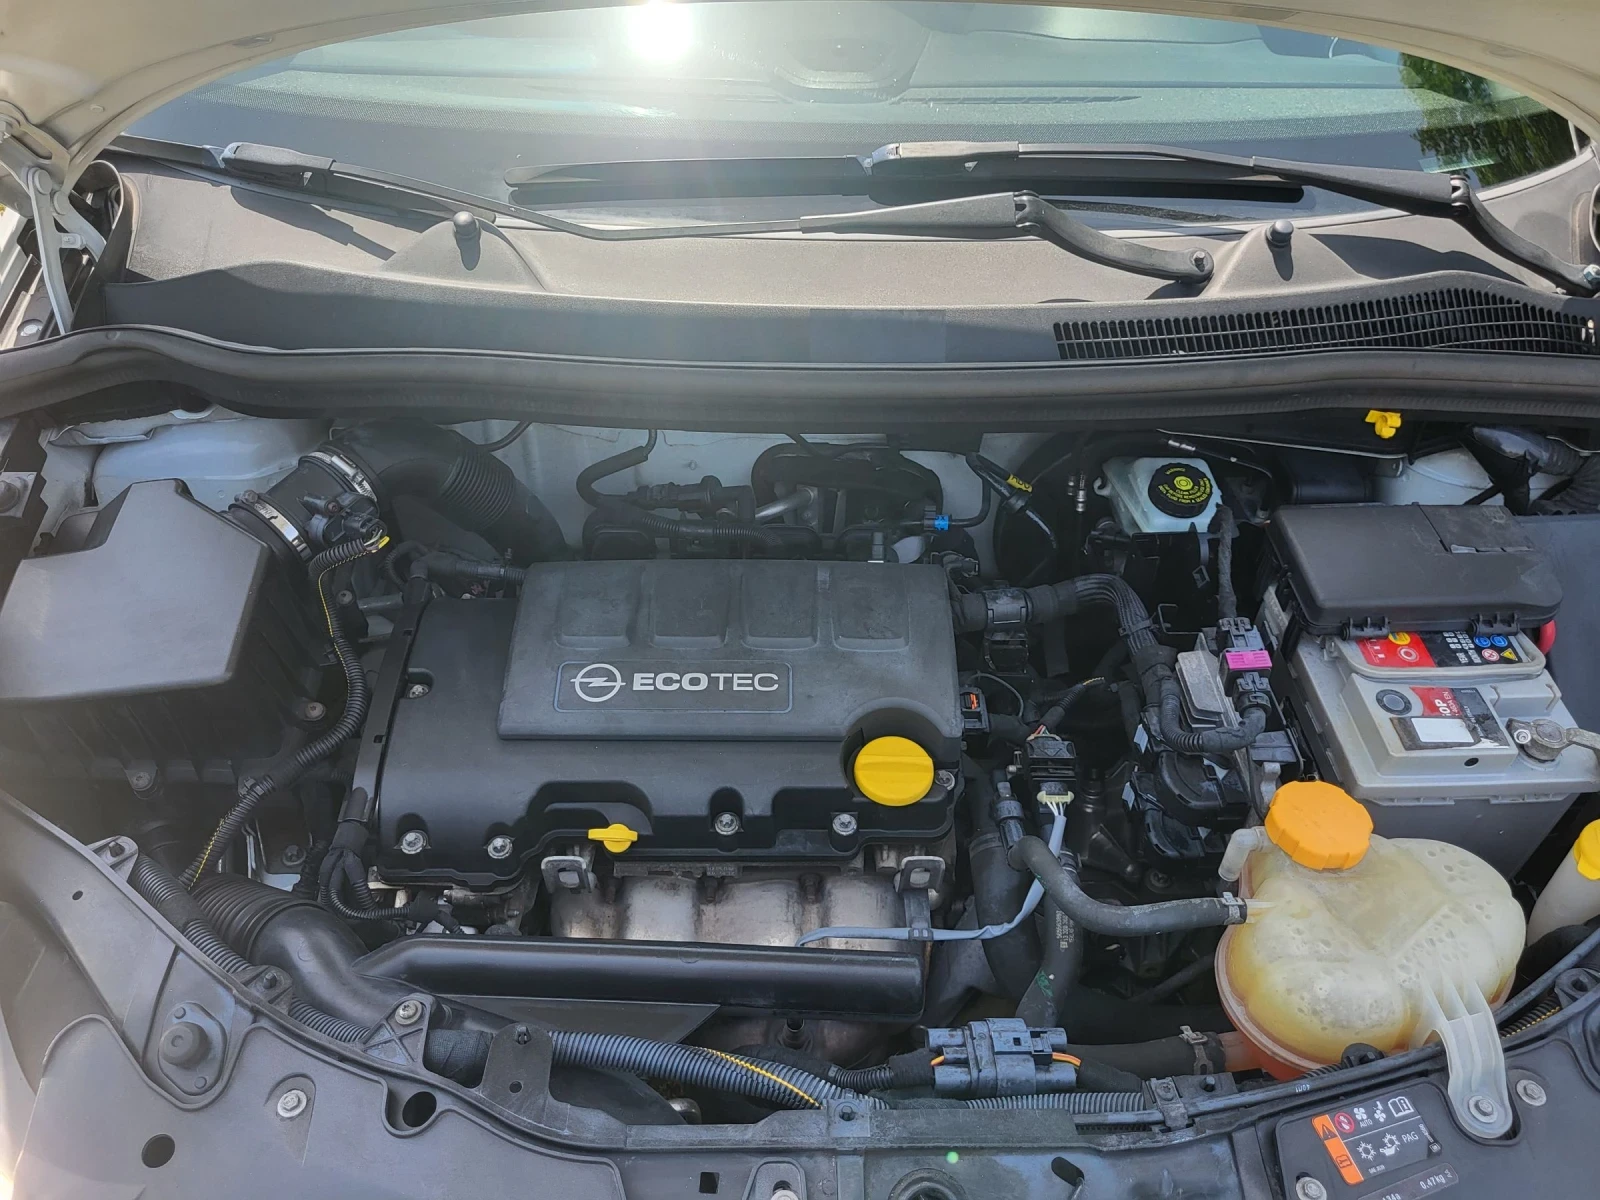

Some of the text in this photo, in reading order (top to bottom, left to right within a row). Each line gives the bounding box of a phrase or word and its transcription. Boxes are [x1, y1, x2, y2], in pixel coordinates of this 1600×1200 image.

[633, 672, 779, 691] ECOTEC
[1359, 1118, 1373, 1128] AUTO
[1401, 1131, 1419, 1144] PAG
[1419, 1173, 1446, 1190] 0.47kg
